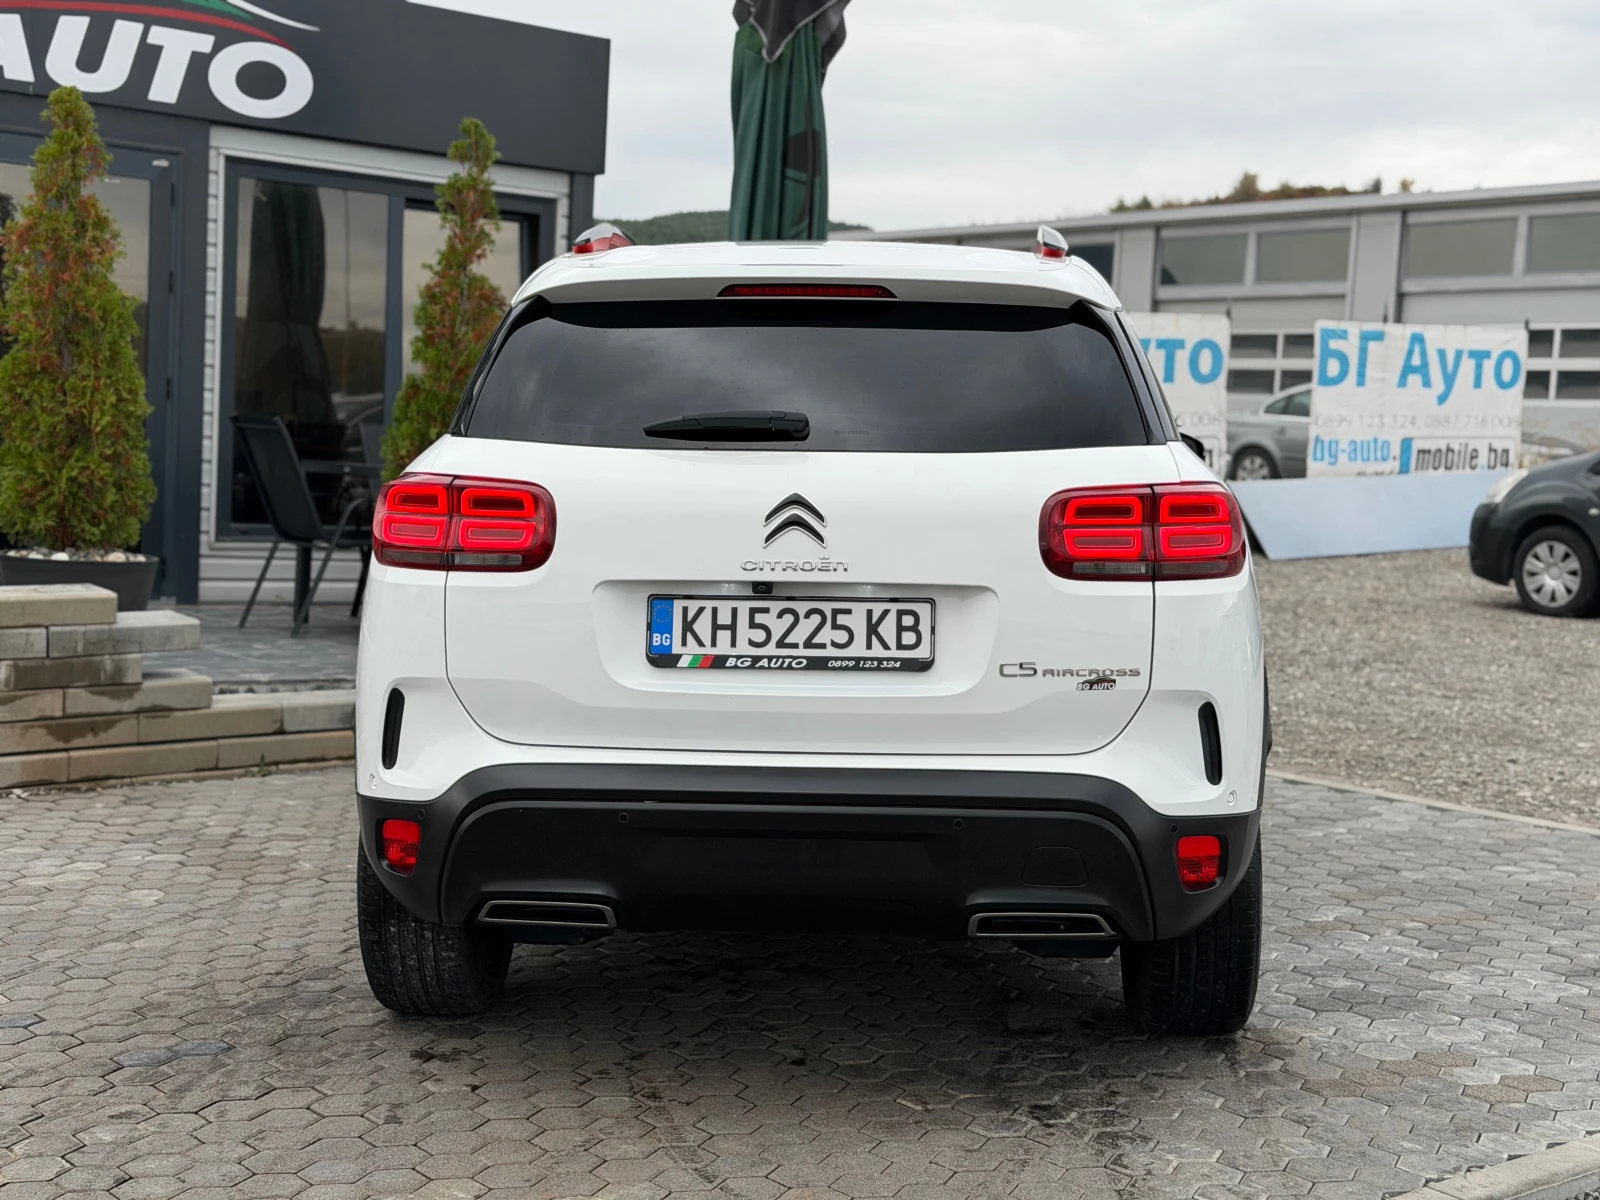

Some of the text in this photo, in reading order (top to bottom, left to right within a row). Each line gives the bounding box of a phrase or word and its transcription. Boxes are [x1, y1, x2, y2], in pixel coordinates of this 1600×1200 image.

[1317, 328, 1521, 406] БГ Ауто
[748, 607, 855, 650] 5225
[652, 633, 671, 646] BG
[725, 657, 901, 669] BG AUTO 0899 123 324
[999, 662, 1141, 678] C5 AIRCROSS
[1076, 682, 1116, 690] BG AUTO
